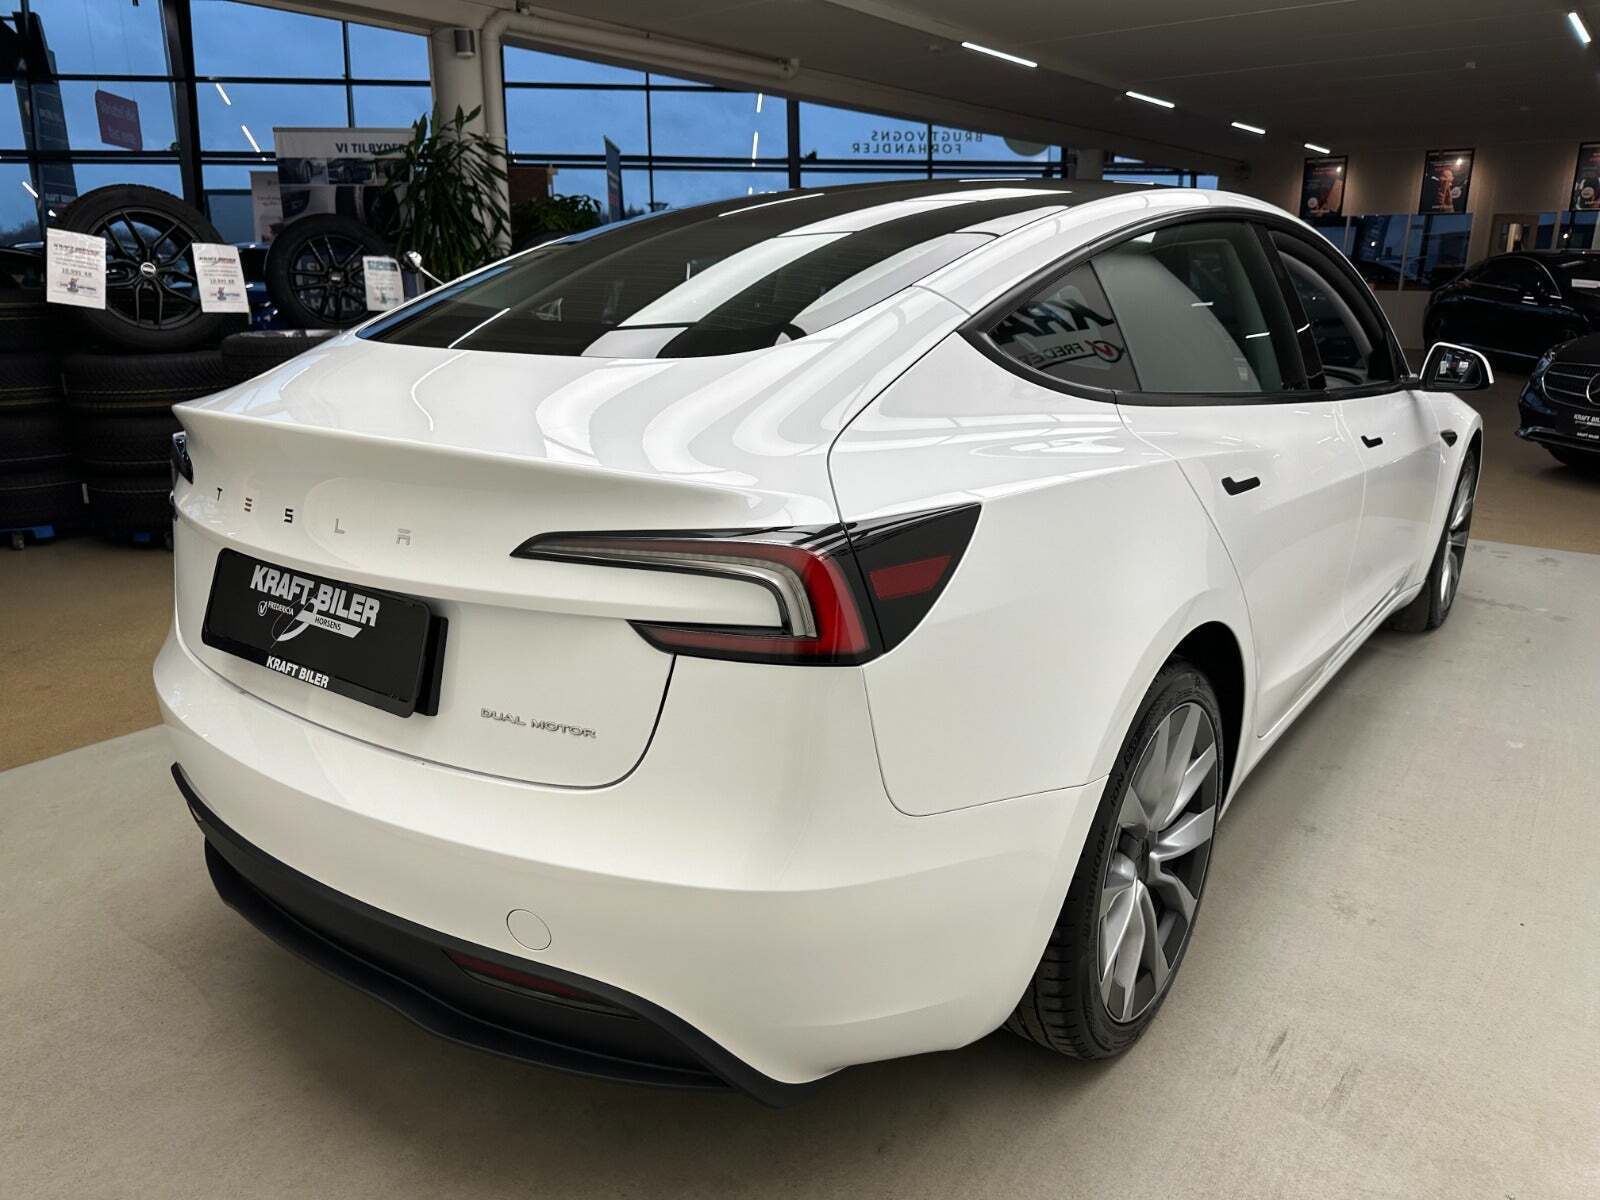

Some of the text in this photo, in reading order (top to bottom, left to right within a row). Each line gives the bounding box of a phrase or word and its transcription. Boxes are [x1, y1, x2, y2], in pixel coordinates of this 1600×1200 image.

[335, 143, 348, 153] VI
[217, 487, 411, 546] TESLA
[250, 564, 380, 627] KRAFT BILER
[314, 616, 342, 631] HORSENS
[266, 655, 330, 688] KRAFT BILER
[480, 707, 597, 739] DUAL MOTOR
